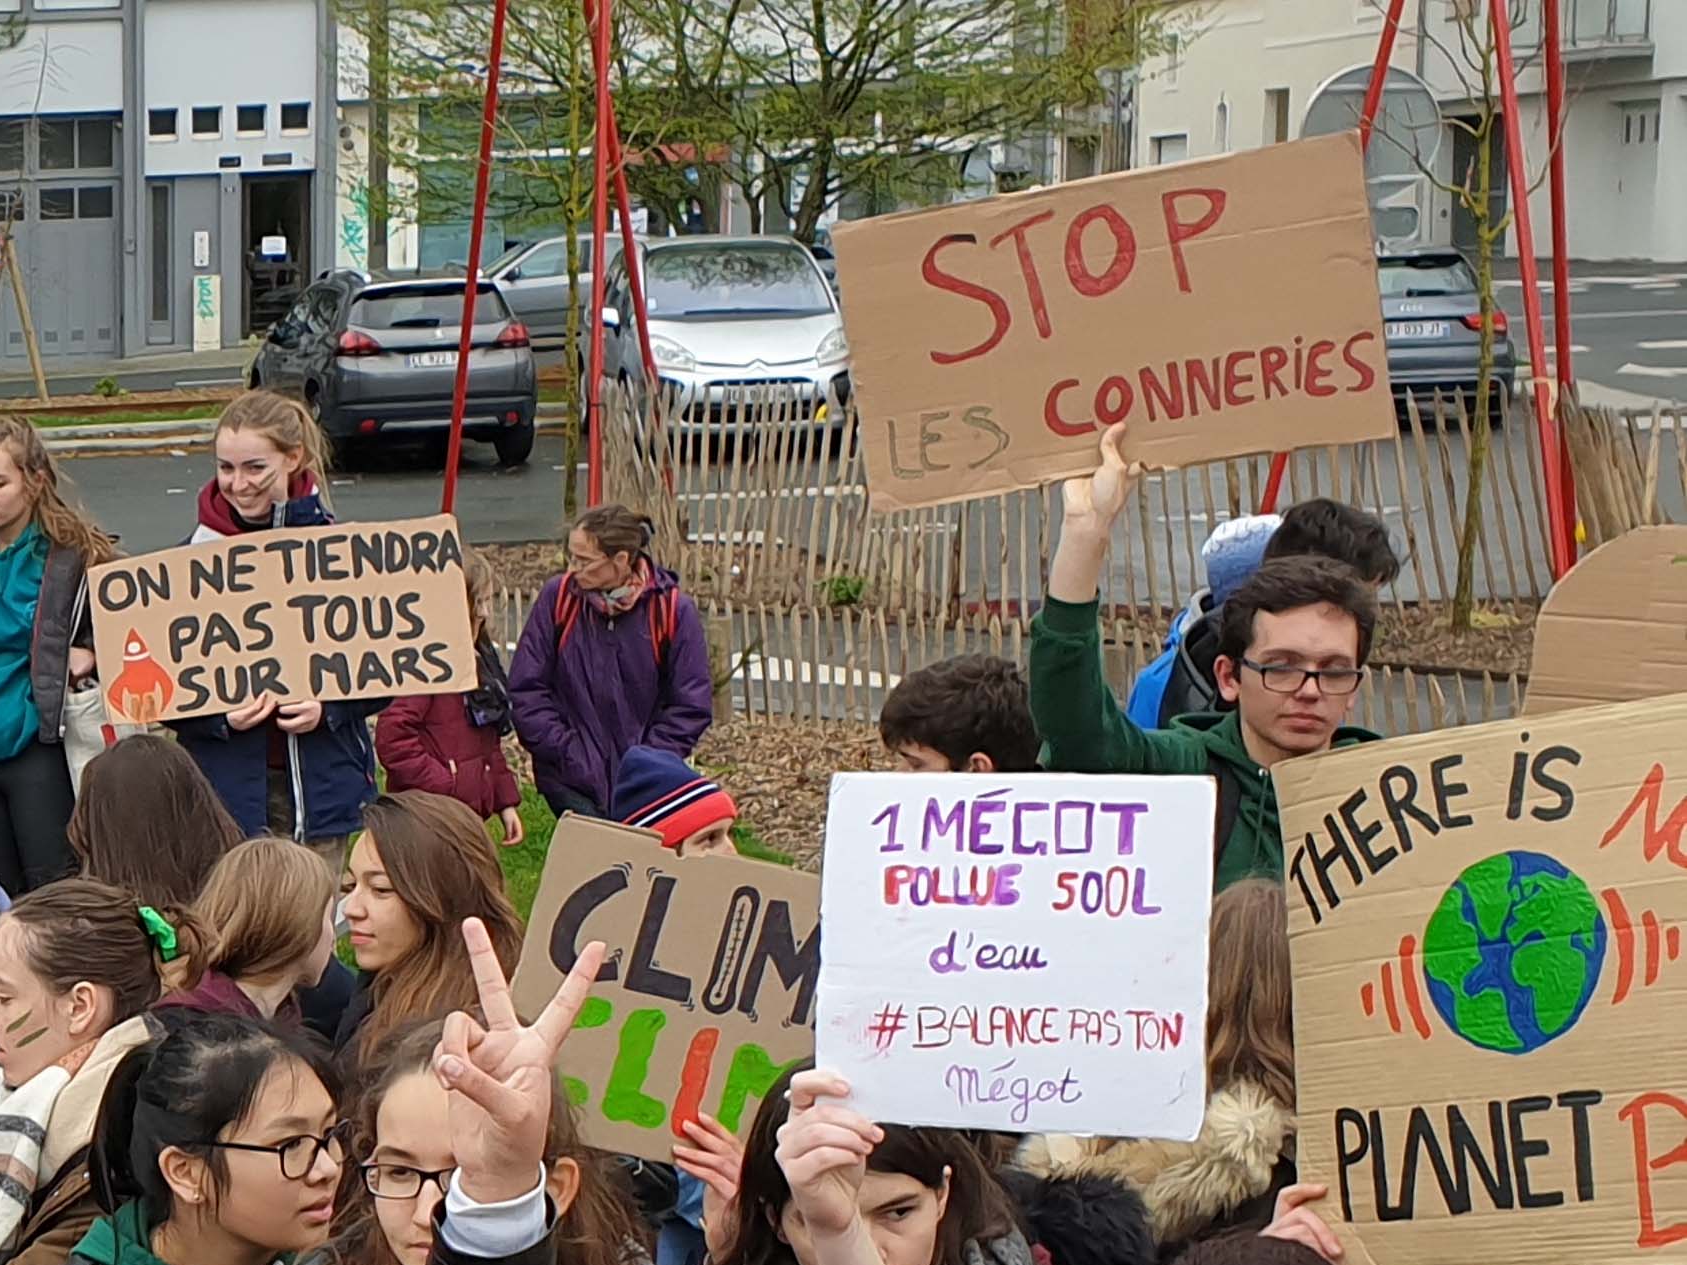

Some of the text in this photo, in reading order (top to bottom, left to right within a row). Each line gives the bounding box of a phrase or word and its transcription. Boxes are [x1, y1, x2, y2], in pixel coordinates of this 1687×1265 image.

[921, 187, 1227, 364] STOP
[888, 406, 1010, 481] LES
[98, 529, 463, 612] ON NE TIENDRA
[168, 592, 425, 664] PAS TOUS
[176, 642, 454, 713] SUR MARS
[870, 788, 1148, 856] 1 MÉGOT
[1287, 753, 1473, 925] THERE
[884, 863, 1022, 906] POLLUE
[928, 931, 1048, 974] d'eau
[1334, 1089, 1603, 1223] PLANET
